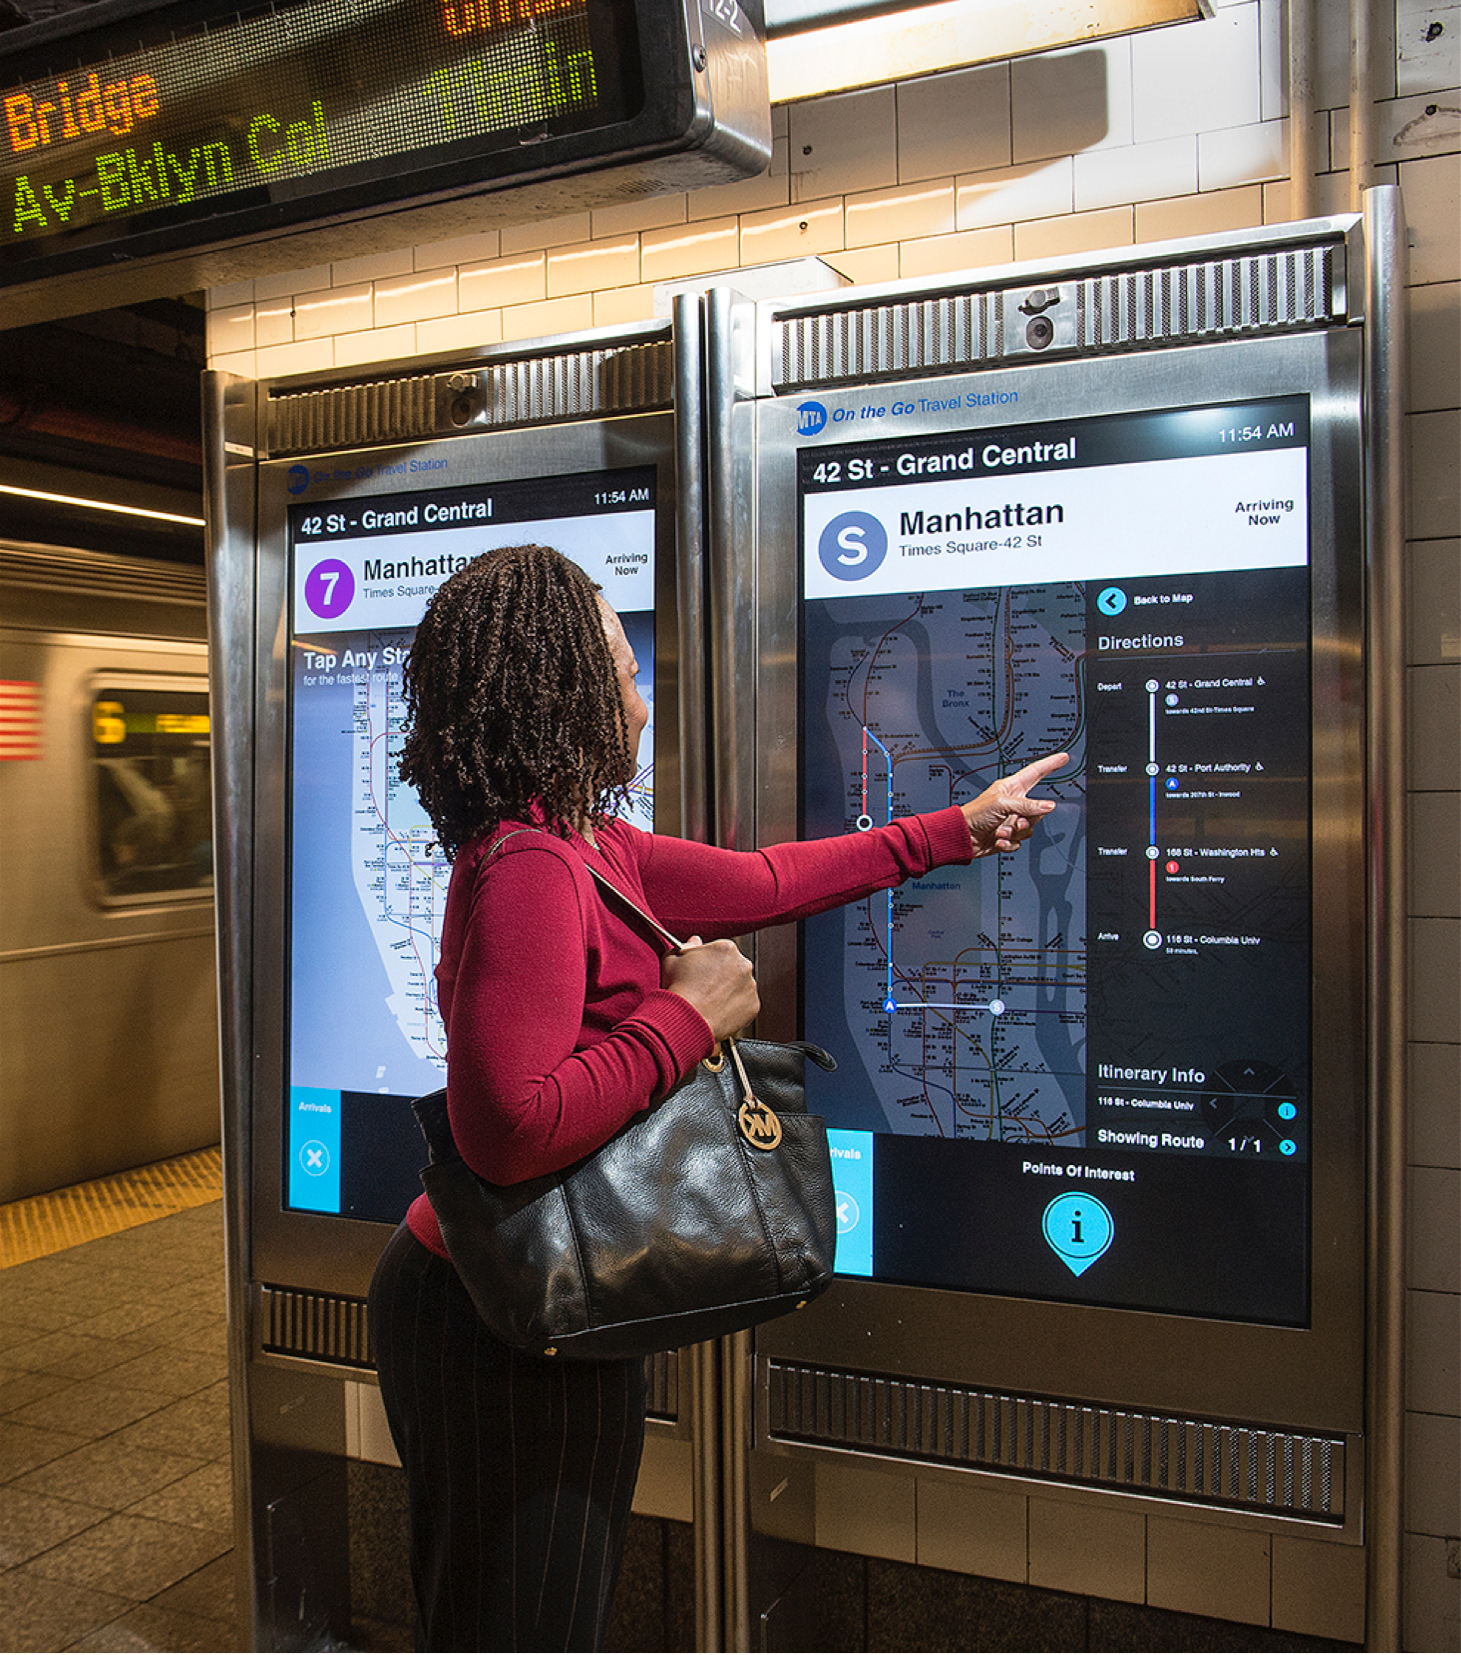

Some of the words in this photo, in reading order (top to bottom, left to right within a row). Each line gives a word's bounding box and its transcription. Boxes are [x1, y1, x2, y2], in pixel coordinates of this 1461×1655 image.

[4, 73, 160, 152] Bridge
[13, 141, 234, 232] Av-Bklyn
[247, 100, 328, 173] Col
[832, 408, 855, 422] On
[860, 404, 886, 419] the
[891, 401, 915, 415] Go
[919, 395, 961, 413] Travel
[966, 391, 1019, 408] Station
[1219, 425, 1262, 442] 11:54
[1266, 422, 1295, 438] AM
[813, 462, 841, 483] 42
[847, 458, 874, 481] St
[897, 448, 975, 476] Grand
[982, 437, 1077, 467] Central
[314, 471, 331, 483] On
[333, 469, 352, 481] the
[356, 466, 374, 479] Go
[376, 461, 407, 476] Travel
[410, 458, 448, 473] Station
[594, 490, 626, 505] 11:54
[629, 487, 650, 502] AM
[1235, 499, 1294, 513] Arriving
[301, 516, 322, 535] 42
[326, 514, 346, 533] St
[362, 506, 419, 530] Grand
[423, 498, 493, 524] Central
[900, 503, 1064, 535] Manhattan
[1248, 514, 1281, 525] Now
[837, 526, 868, 566] S
[899, 543, 942, 557] Times
[946, 535, 1022, 555] Square-42
[1026, 534, 1042, 547] St
[606, 553, 648, 565] Arriving
[363, 554, 476, 581] Manhatta
[614, 566, 639, 576] Now
[319, 572, 340, 606] 7
[363, 588, 394, 599] Times
[1134, 595, 1159, 606] Back
[1160, 594, 1171, 604] to
[1172, 593, 1194, 605] Map
[1098, 633, 1184, 651] Directions
[303, 651, 337, 673] Tap
[341, 649, 378, 671] Any
[382, 647, 411, 665] Sta
[303, 674, 317, 686] for
[319, 674, 334, 686] the
[336, 672, 370, 685] fastest
[1097, 682, 1123, 692] Depart
[1165, 680, 1177, 690] 42
[1178, 680, 1188, 689] St
[1194, 679, 1220, 689] Grand
[1222, 677, 1254, 688] Central
[947, 690, 965, 698] The
[942, 700, 970, 708] Bronx
[1097, 765, 1128, 773] Transfer
[1165, 763, 1177, 773] 42
[1178, 763, 1188, 773] St
[1194, 763, 1213, 773] Port
[1214, 763, 1252, 774] Authority
[1097, 847, 1128, 856] Transfer
[1183, 848, 1193, 857] St
[1199, 848, 1250, 859] Washington
[1183, 935, 1193, 944] St
[1200, 935, 1240, 945] Columbia
[1240, 936, 1261, 945] Univ
[1098, 1064, 1168, 1085] Itinerary
[1172, 1067, 1206, 1083] Info
[299, 1102, 332, 1113] Arrivals
[1098, 1096, 1113, 1106] 116
[1115, 1097, 1124, 1107] St
[1130, 1098, 1172, 1109] Columbia
[1173, 1100, 1195, 1111] Univ
[1098, 1129, 1158, 1148] Showing
[1161, 1133, 1205, 1149] Route
[1022, 1161, 1062, 1177] Points
[1066, 1165, 1082, 1178] Of
[1085, 1166, 1135, 1182] Interest
